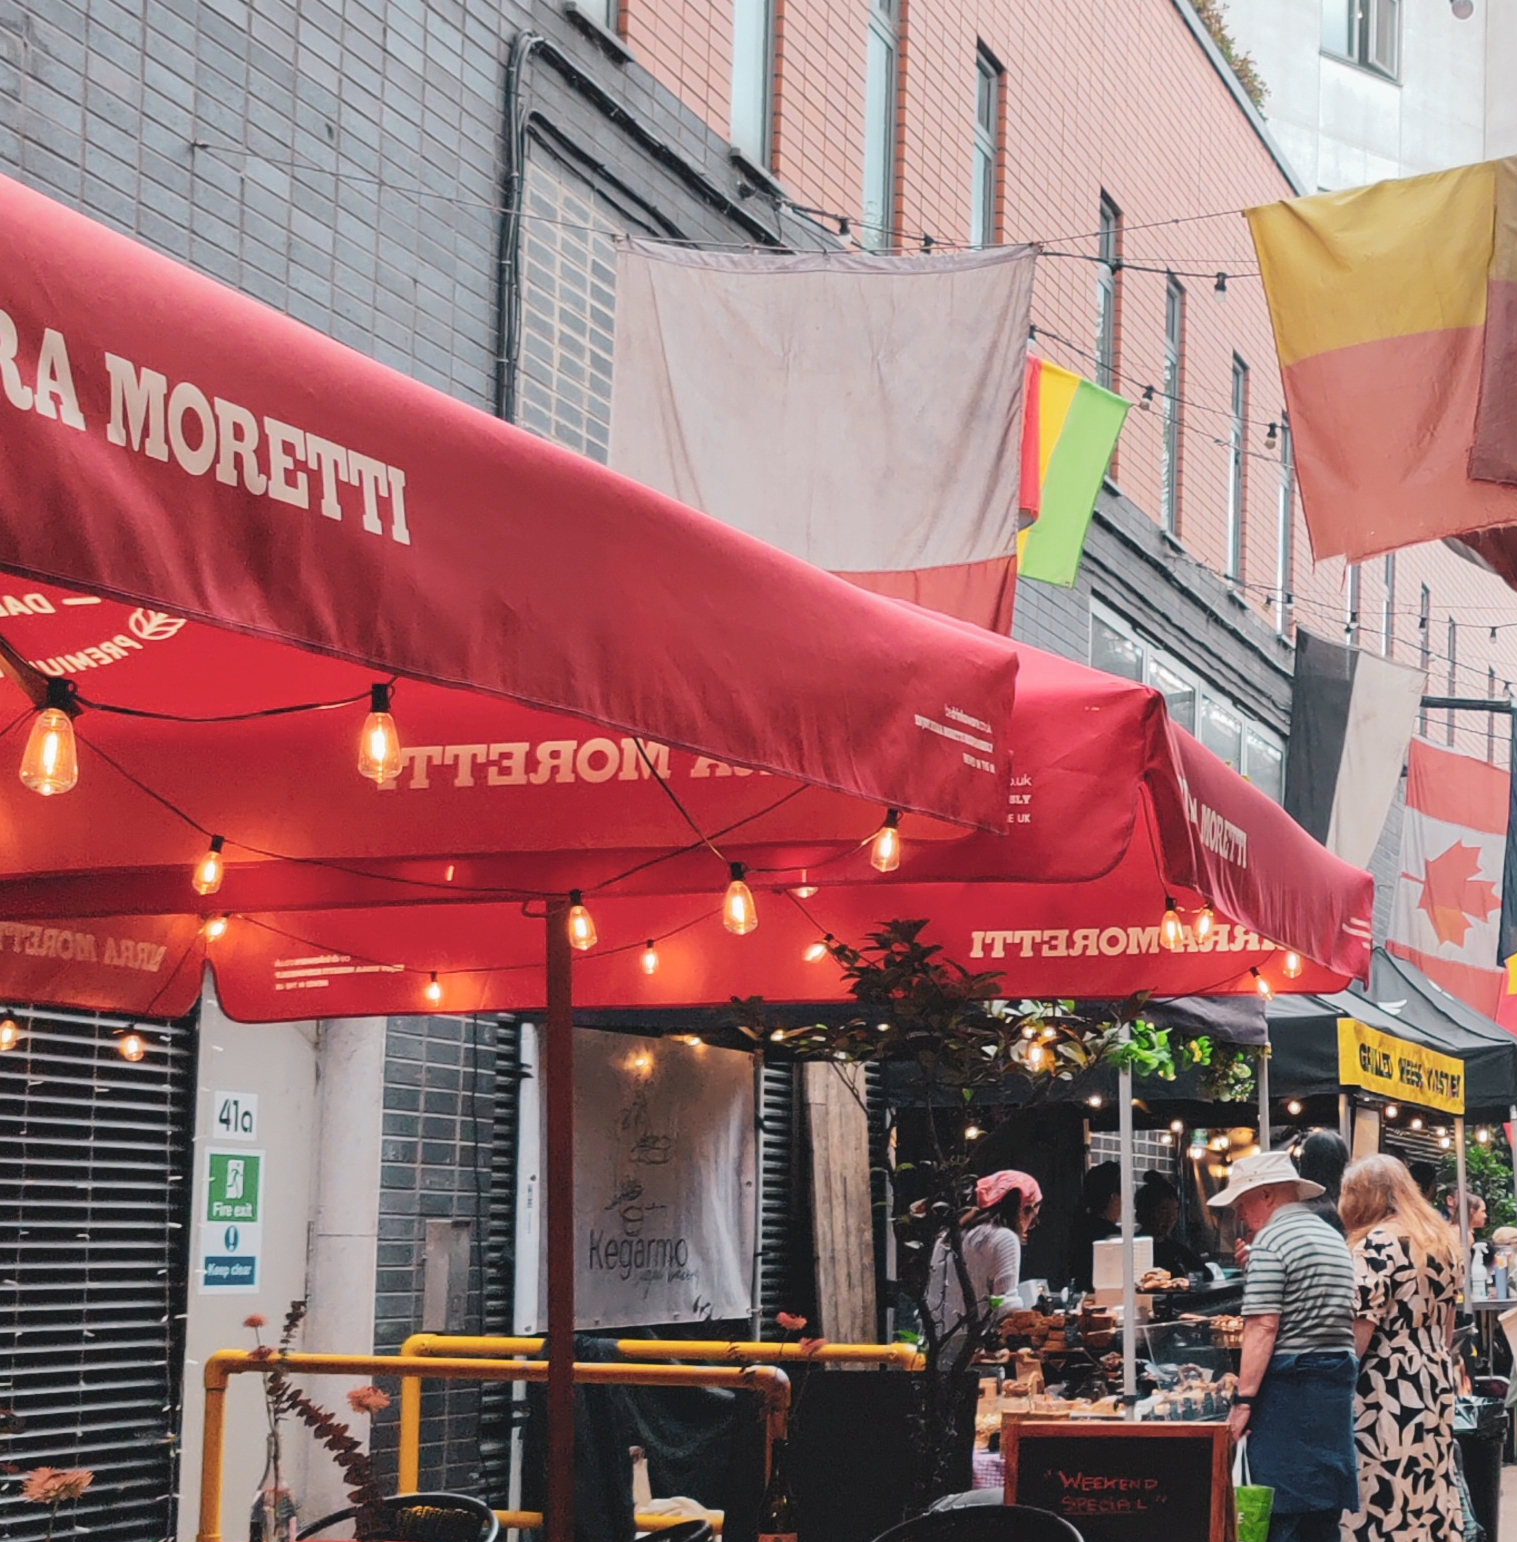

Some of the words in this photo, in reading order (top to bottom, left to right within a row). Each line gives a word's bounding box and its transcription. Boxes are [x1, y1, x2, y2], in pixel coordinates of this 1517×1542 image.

[104, 351, 411, 546] MORETTI
[1201, 803, 1247, 869] MORETTI
[218, 1098, 253, 1133] 41a
[212, 1201, 233, 1217] Fire
[234, 1202, 253, 1217] exit
[207, 1263, 230, 1280] Keep
[588, 1228, 690, 1281] Kegarmo
